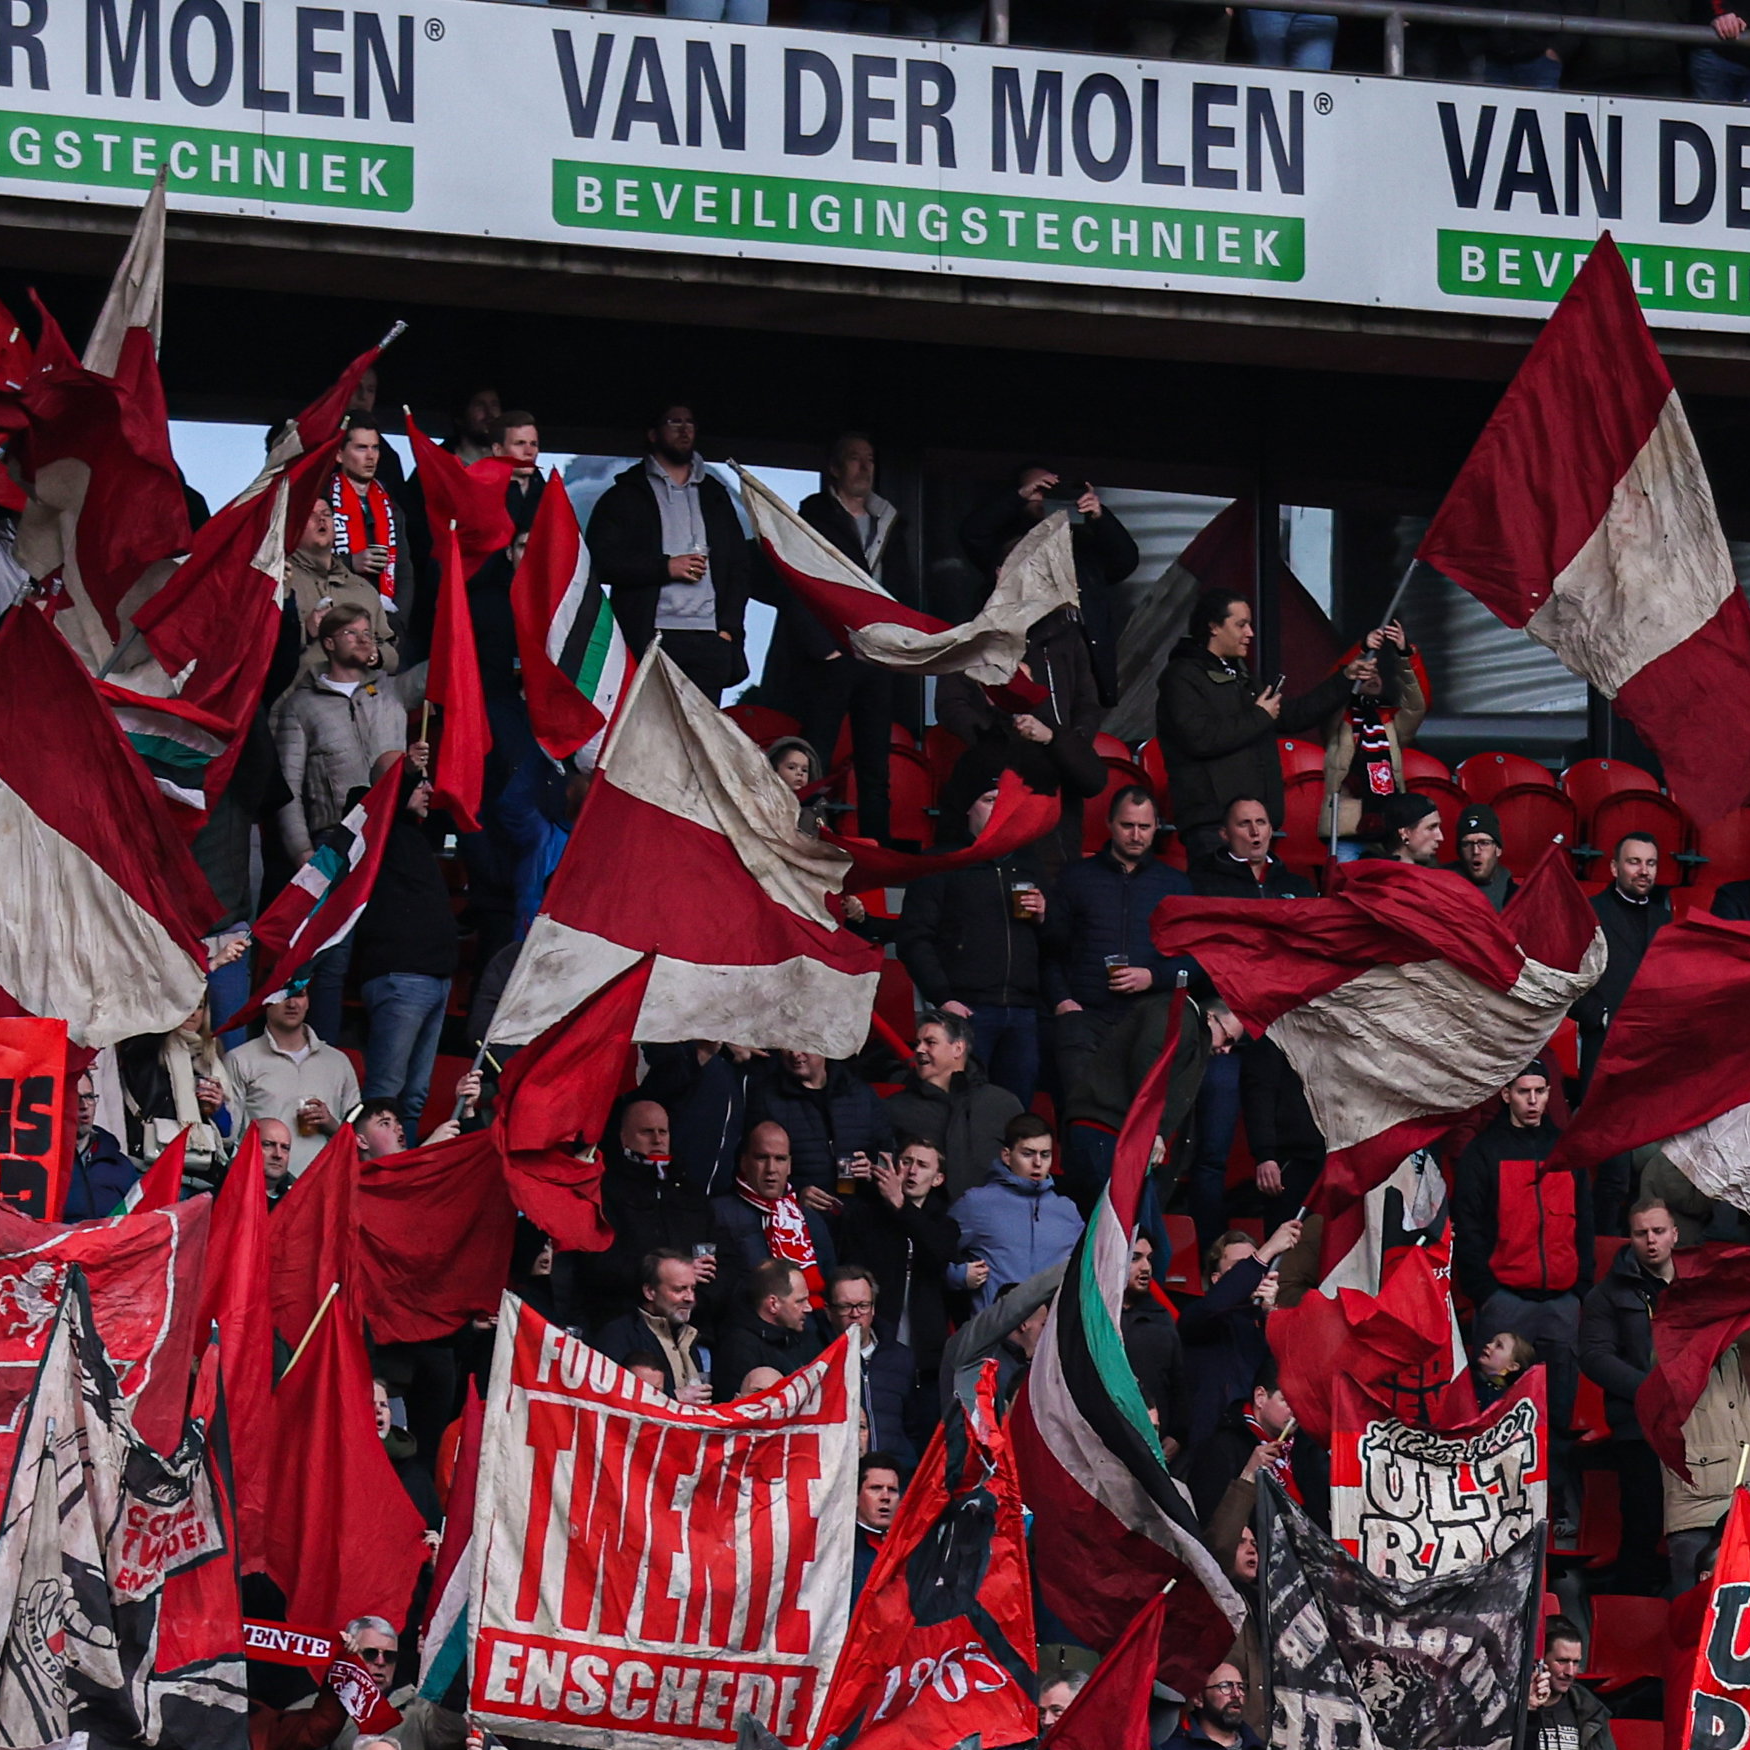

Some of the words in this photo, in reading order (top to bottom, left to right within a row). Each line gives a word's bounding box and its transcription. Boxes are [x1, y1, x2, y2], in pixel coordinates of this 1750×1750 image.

[86, 0, 416, 124] MOLEN
[552, 29, 748, 152] VAN
[783, 47, 957, 170] DER
[991, 66, 1306, 196] MOLEN
[1437, 102, 1624, 220] VAN
[576, 175, 1282, 268] BEVEILIGINGSTECHNIEK
[513, 1400, 821, 1654] TWENTE
[1361, 1438, 1537, 1520] ULT
[483, 1639, 804, 1737] ENSCHEDE
